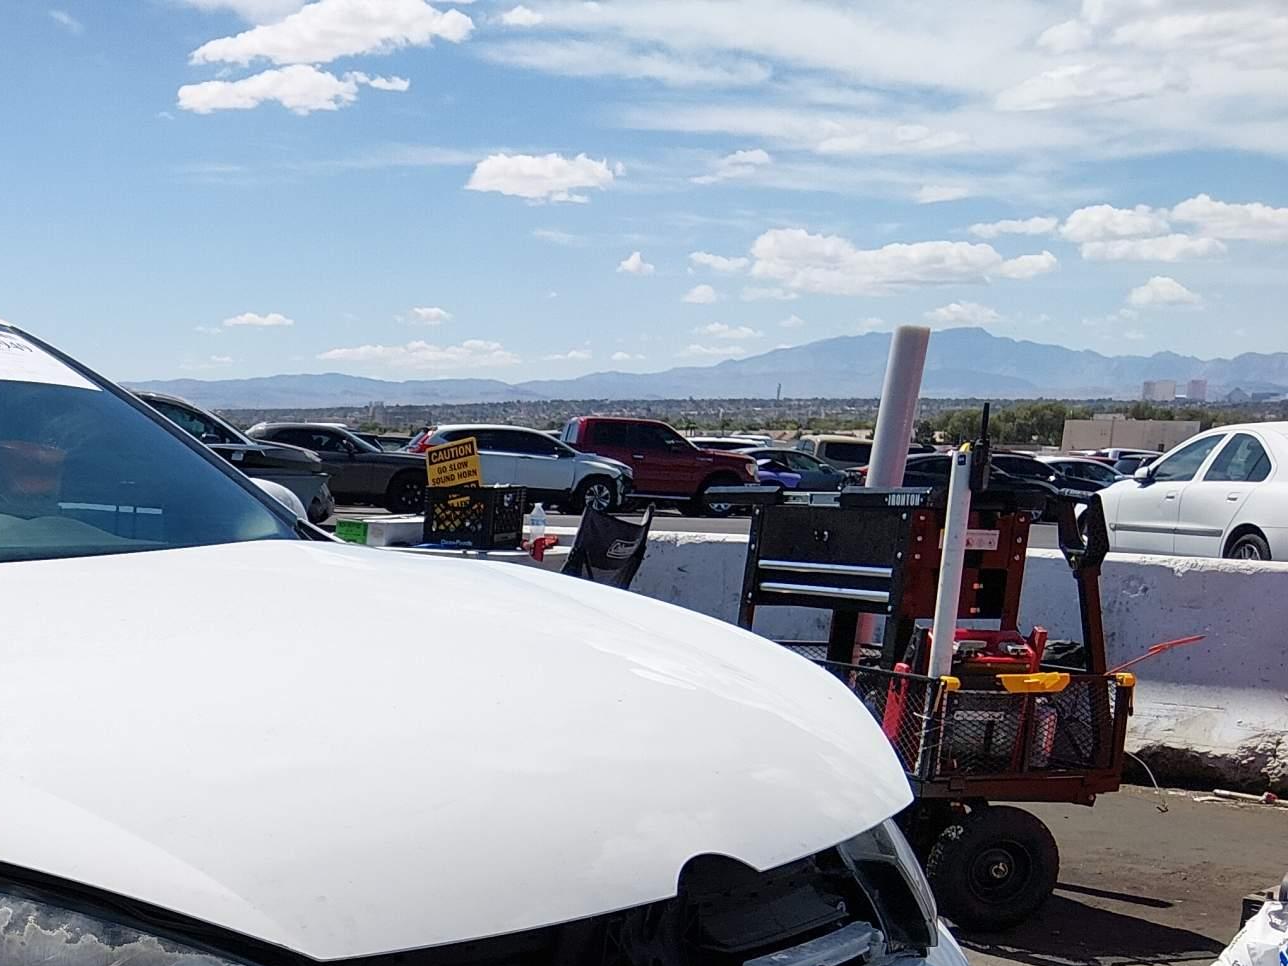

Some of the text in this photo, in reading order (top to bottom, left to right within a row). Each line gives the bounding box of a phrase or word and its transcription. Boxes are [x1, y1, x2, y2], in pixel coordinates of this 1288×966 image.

[431, 443, 472, 463] CAUTION
[437, 461, 469, 475] GO SLOW
[431, 468, 478, 485] SOUND HORN
[887, 493, 921, 506] IRONTON
